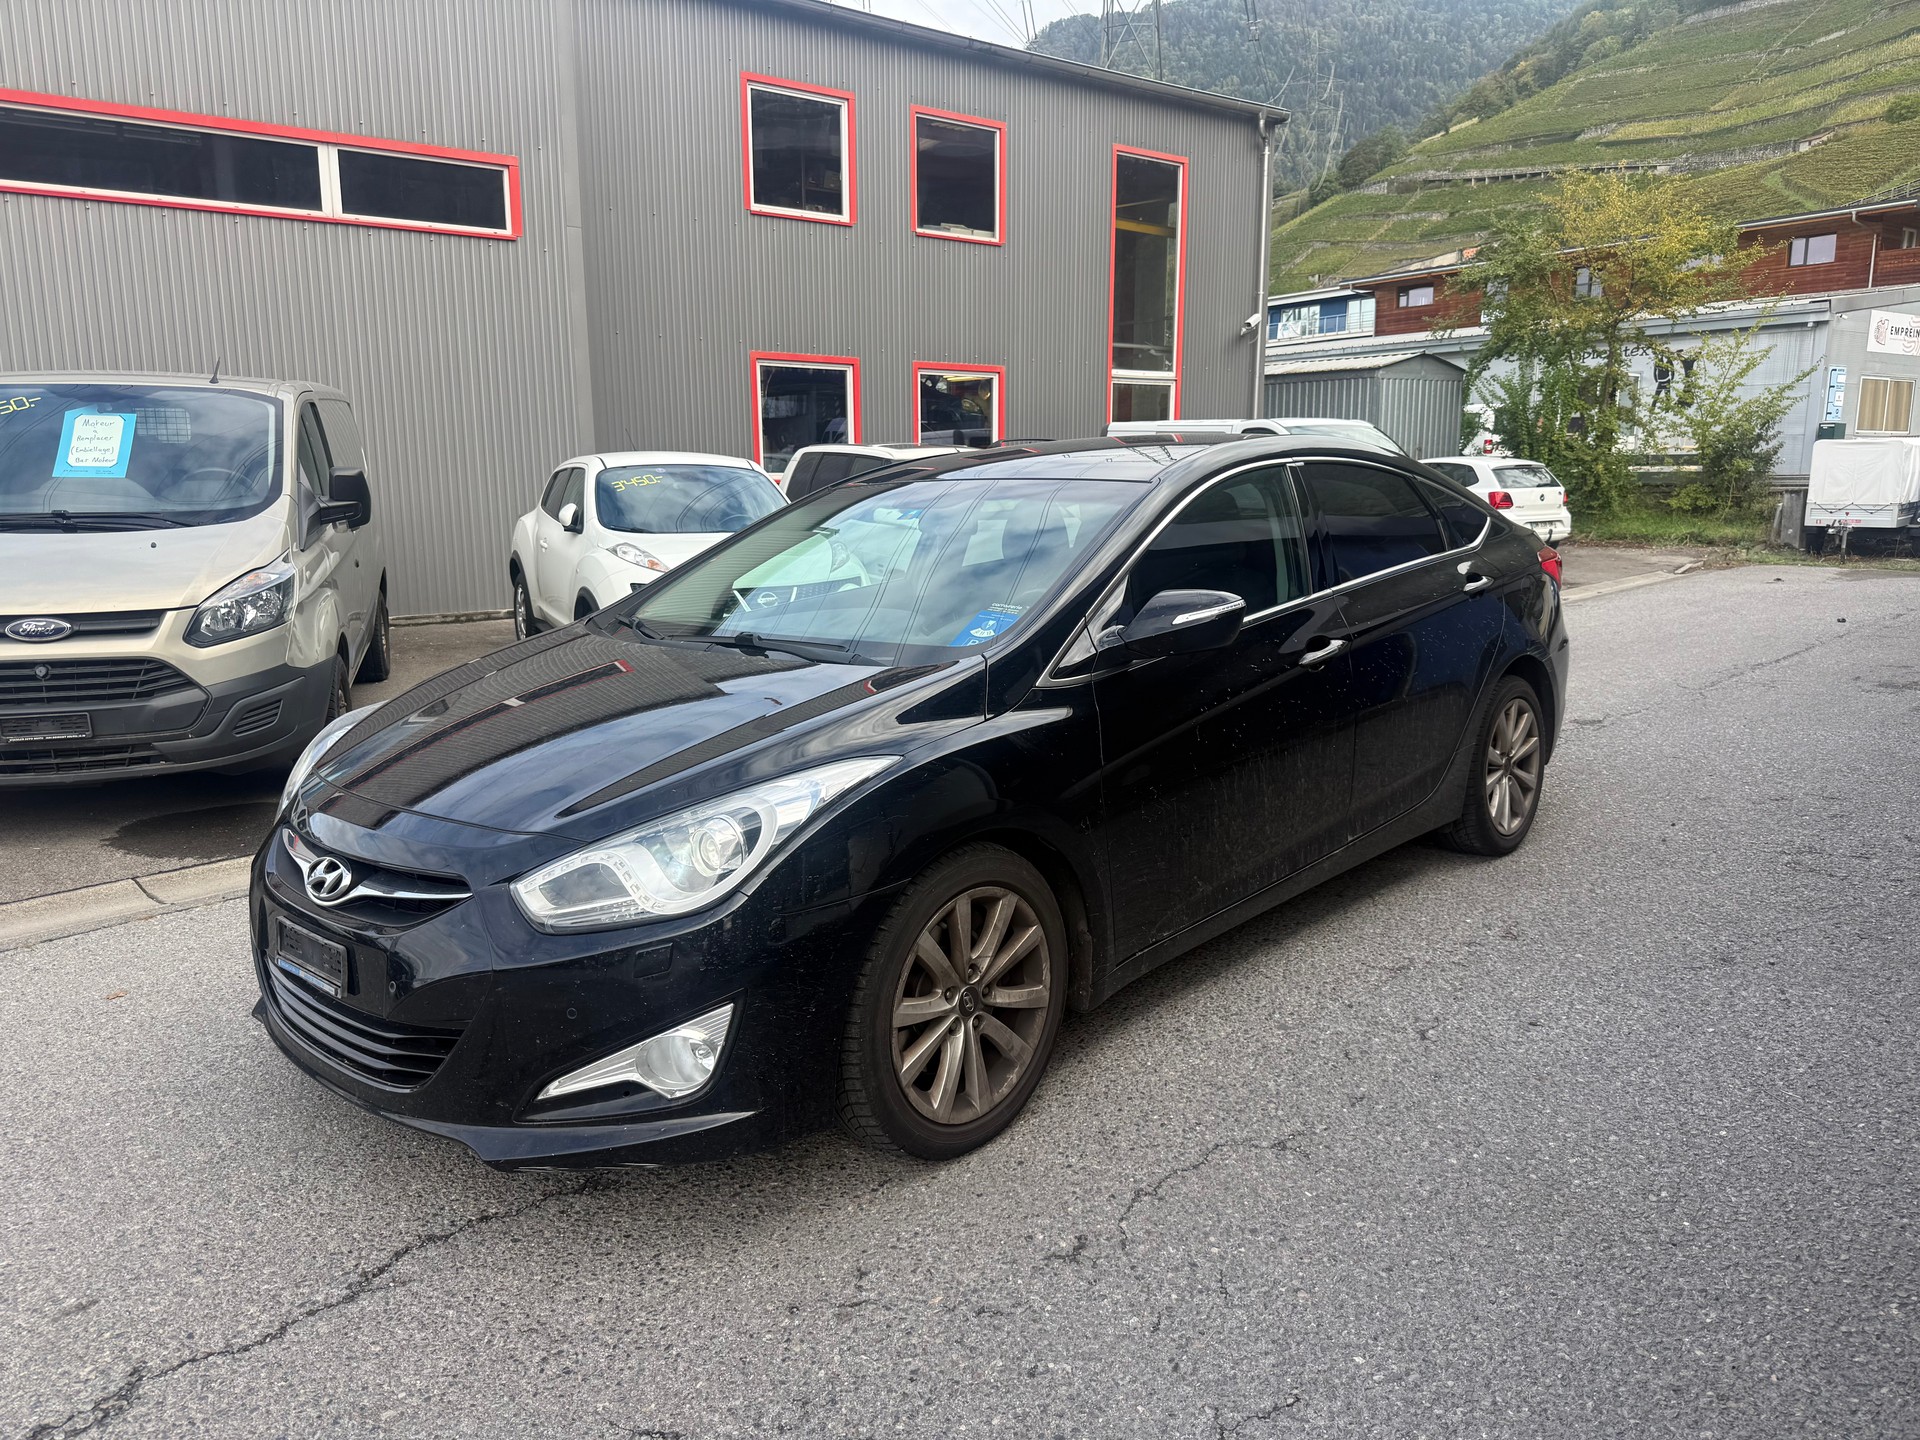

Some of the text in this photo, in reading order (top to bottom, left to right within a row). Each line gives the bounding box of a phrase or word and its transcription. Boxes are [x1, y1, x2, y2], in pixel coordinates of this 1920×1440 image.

[82, 418, 115, 428] Moteur
[76, 434, 114, 444] Remplacer
[20, 621, 56, 636] Ford
